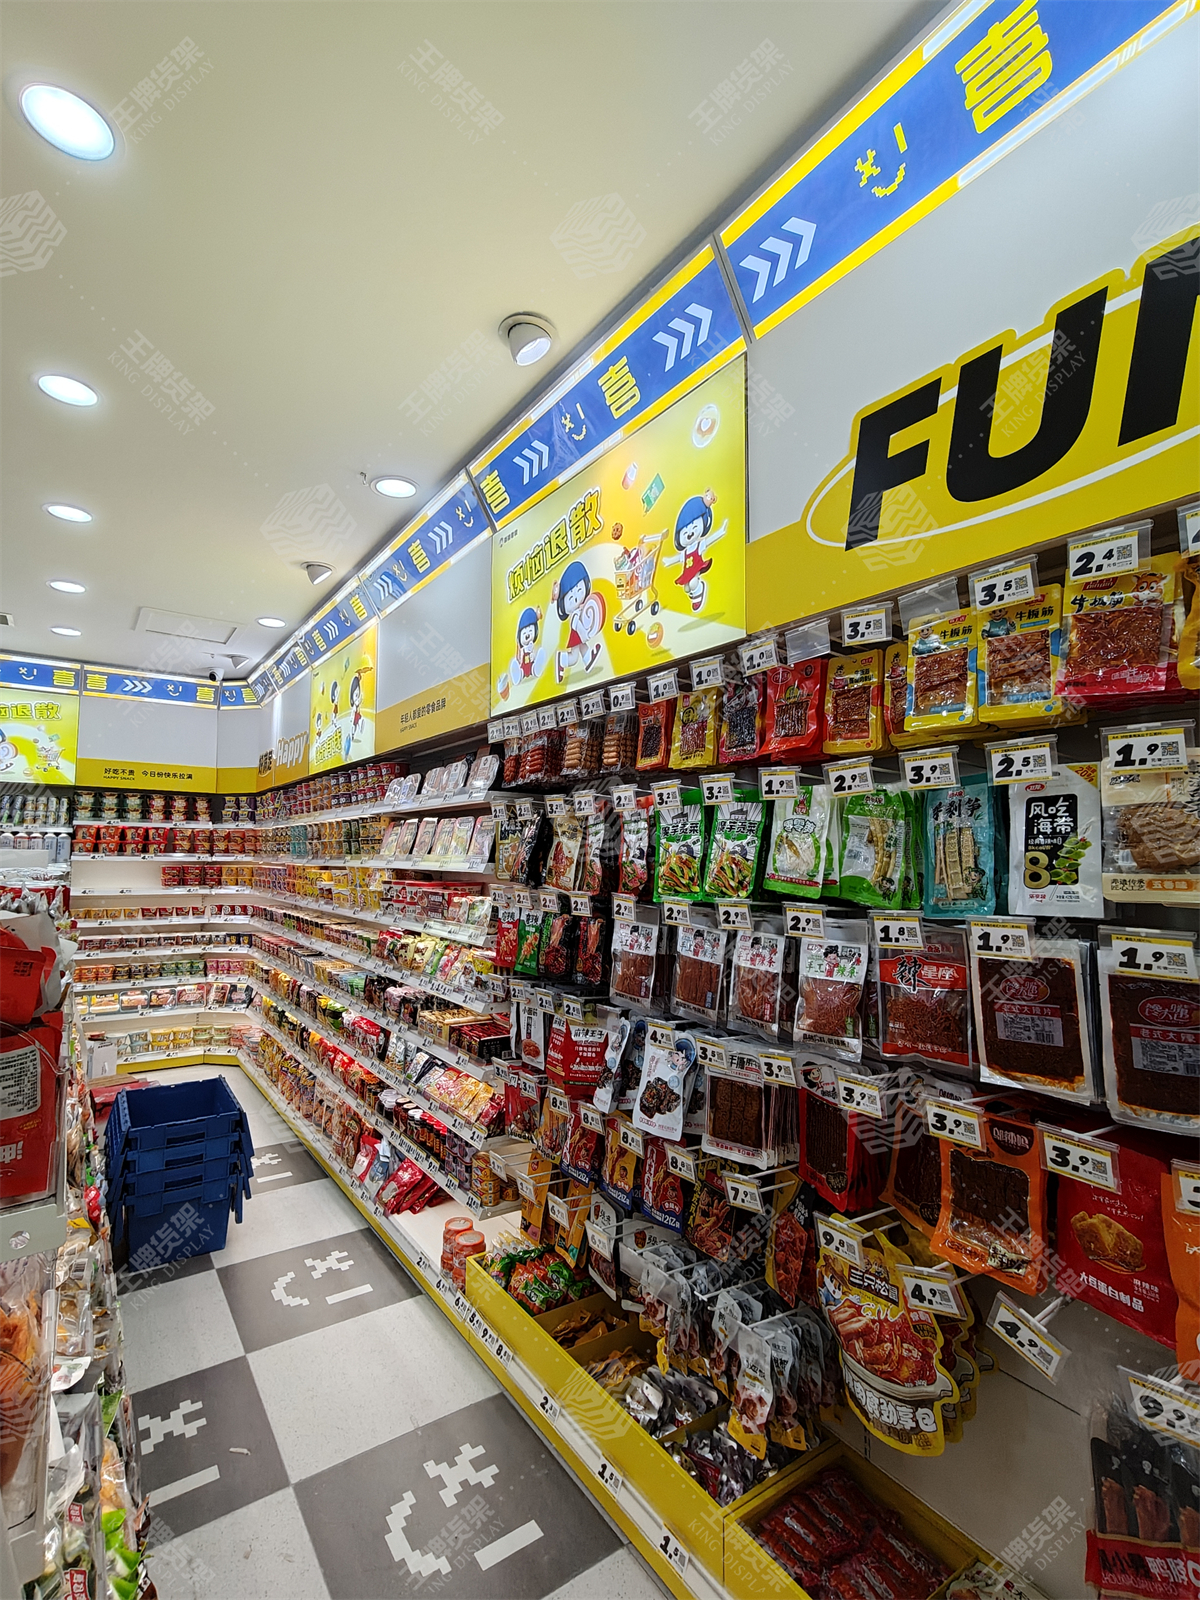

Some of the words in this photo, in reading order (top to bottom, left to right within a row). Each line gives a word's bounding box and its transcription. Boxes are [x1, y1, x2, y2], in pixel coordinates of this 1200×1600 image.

[955, 0, 1053, 134] 喜
[598, 355, 641, 419] 喜
[480, 469, 510, 515] 喜
[507, 486, 604, 602] 烦恼退散
[408, 540, 430, 574] 喜
[1072, 548, 1115, 577] 2.4
[978, 580, 1013, 606] 3.5
[1015, 605, 1054, 621] 牛板筋
[846, 621, 872, 640] 3.5
[746, 651, 765, 669] 1.0
[53, 669, 75, 688] 喜
[86, 674, 108, 692] 喜
[696, 668, 712, 684] 1.0
[196, 686, 216, 702] 喜
[653, 683, 668, 699] 1.0
[584, 702, 596, 716] 2.9
[612, 695, 625, 708] 0.9
[276, 730, 308, 768] Happy
[1114, 743, 1160, 768] 1.9
[908, 764, 938, 785] 3.9
[995, 756, 1031, 779] 2.5
[764, 780, 785, 795] 1.9
[833, 773, 858, 793] 2.9
[616, 795, 628, 808] 2.9
[657, 792, 671, 805] 3.2
[705, 786, 722, 801] 3.2
[1028, 796, 1070, 818] 风吃
[1034, 816, 1074, 835] 海带
[1023, 851, 1051, 889] 8
[572, 900, 584, 912] 2.9
[614, 903, 628, 916] 2.9
[665, 907, 681, 921] 2.9
[722, 910, 739, 925] 2.9
[789, 915, 811, 932] 2.9
[878, 925, 905, 943] 1.8
[977, 931, 1010, 952] 1.9
[1118, 947, 1165, 971] 1.9
[650, 1030, 665, 1045] 4.9
[699, 1046, 716, 1062] 3.5
[763, 1061, 783, 1079] 3.9
[841, 1086, 867, 1106] 3.9
[931, 1112, 962, 1135] 3.9
[669, 1156, 686, 1170] 8.8
[1049, 1145, 1090, 1173] 3.9
[730, 1186, 749, 1204] 7.9
[821, 1229, 846, 1252] 9.8
[910, 1283, 937, 1305] 4.9
[998, 1319, 1039, 1349] 4.9
[1139, 1393, 1187, 1430] 9.9
[598, 1463, 615, 1485] 1.5
[660, 1536, 680, 1560] 1.5
